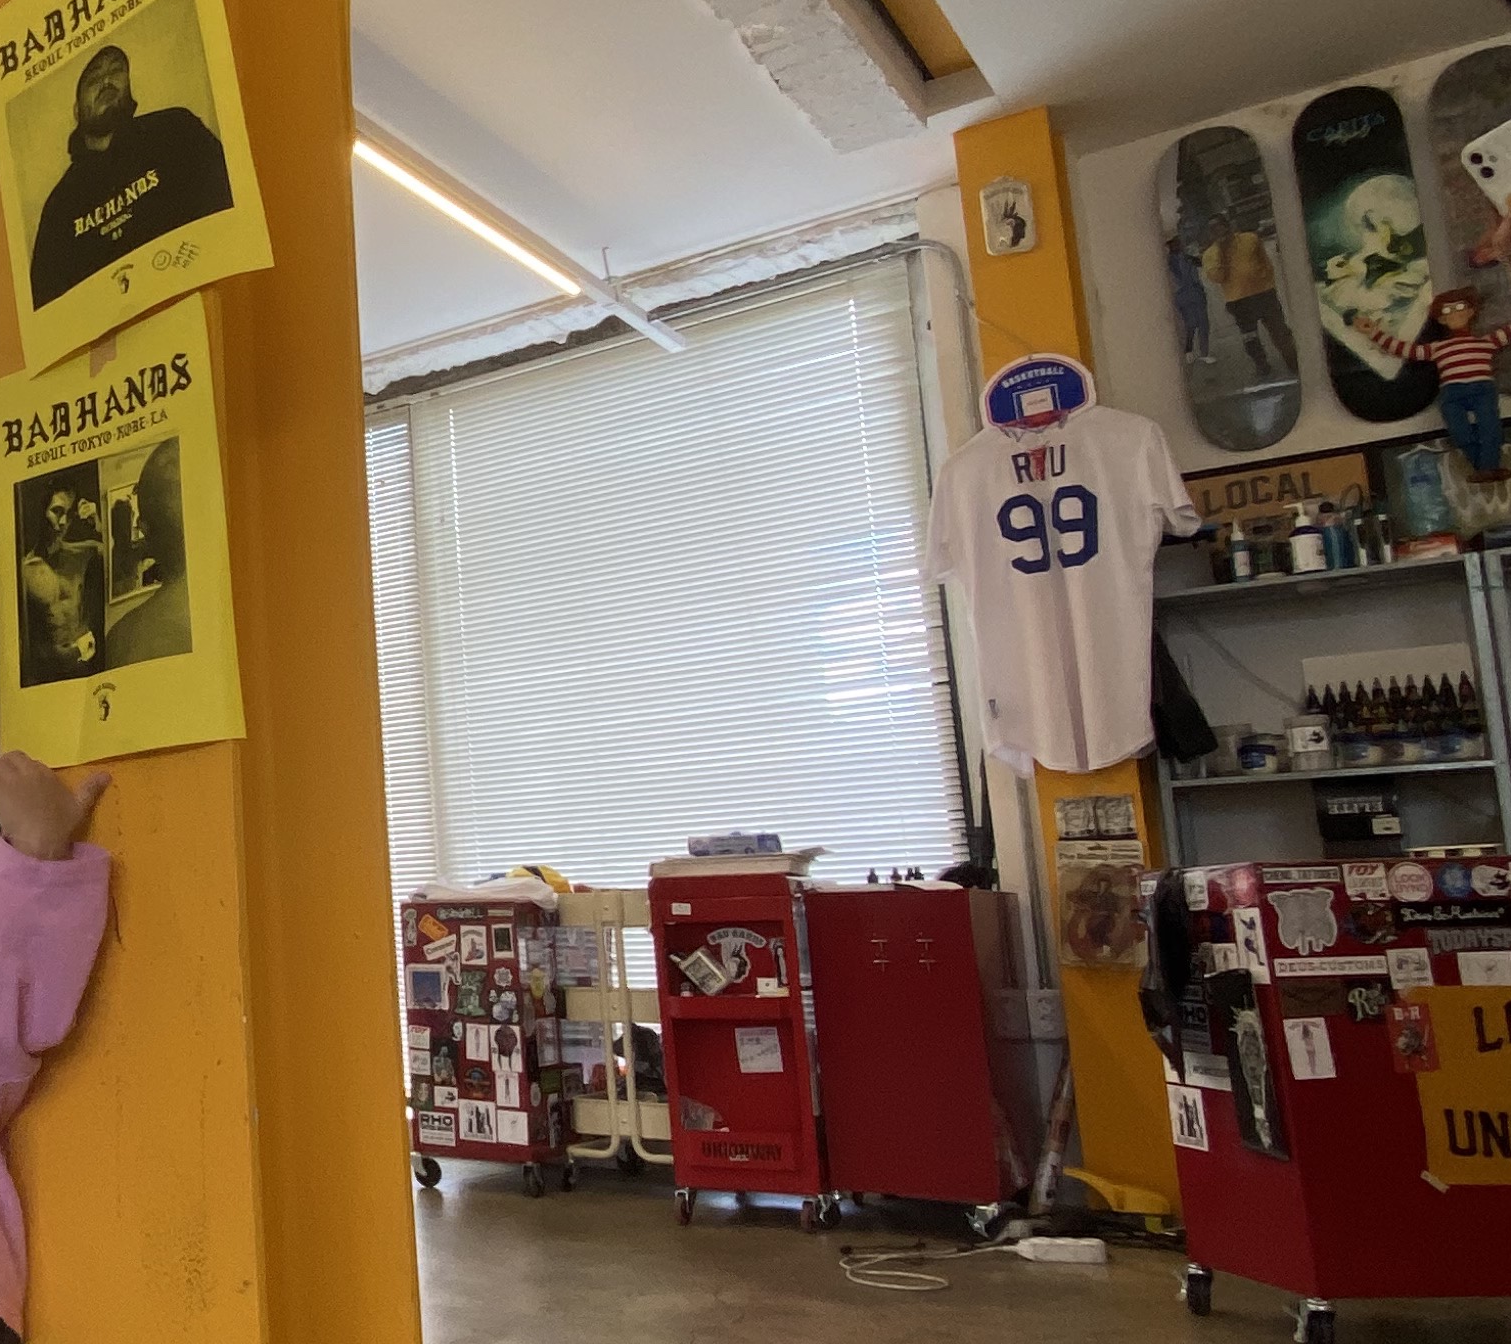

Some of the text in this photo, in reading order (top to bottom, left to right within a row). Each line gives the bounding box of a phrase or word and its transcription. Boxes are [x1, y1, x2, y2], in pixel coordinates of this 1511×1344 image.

[25, 48, 64, 82] SEOUL
[66, 19, 106, 54] TOKYO
[27, 443, 67, 468] SEOUL
[70, 431, 112, 455] TOKYO
[116, 416, 146, 440] KOBE
[1201, 471, 1323, 518] LOCAL
[996, 484, 1099, 575] 99
[1473, 1000, 1511, 1053] L
